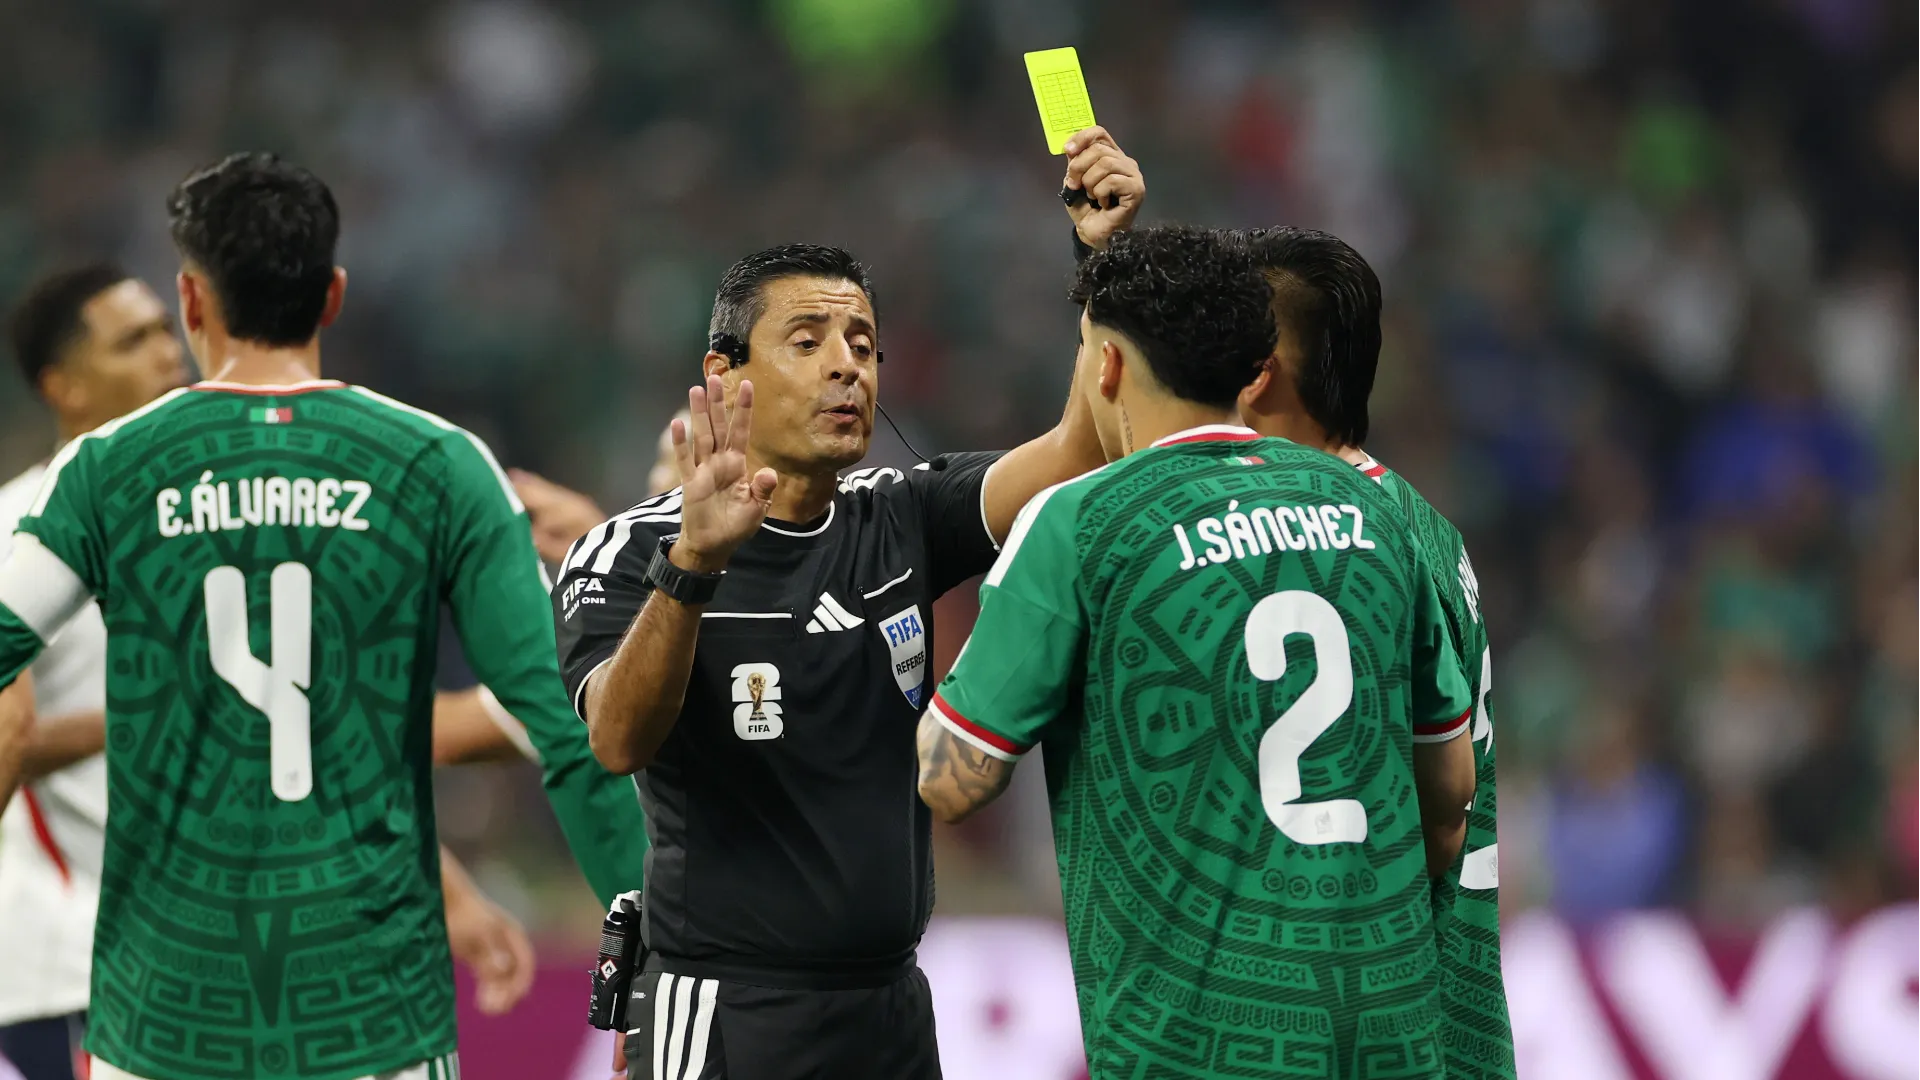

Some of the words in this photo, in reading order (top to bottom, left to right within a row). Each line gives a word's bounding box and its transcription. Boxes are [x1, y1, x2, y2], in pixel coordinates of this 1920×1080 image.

[156, 469, 373, 538] E.ÁLVAREZ
[1172, 499, 1377, 571] J.SÁNCHEZ
[561, 577, 605, 611] FIFA
[581, 596, 607, 605] ONE
[885, 613, 923, 648] FIFA
[895, 650, 925, 676] REFEREE
[203, 562, 313, 802] 4
[747, 724, 771, 734] FIFA
[1244, 590, 1369, 846] 2
